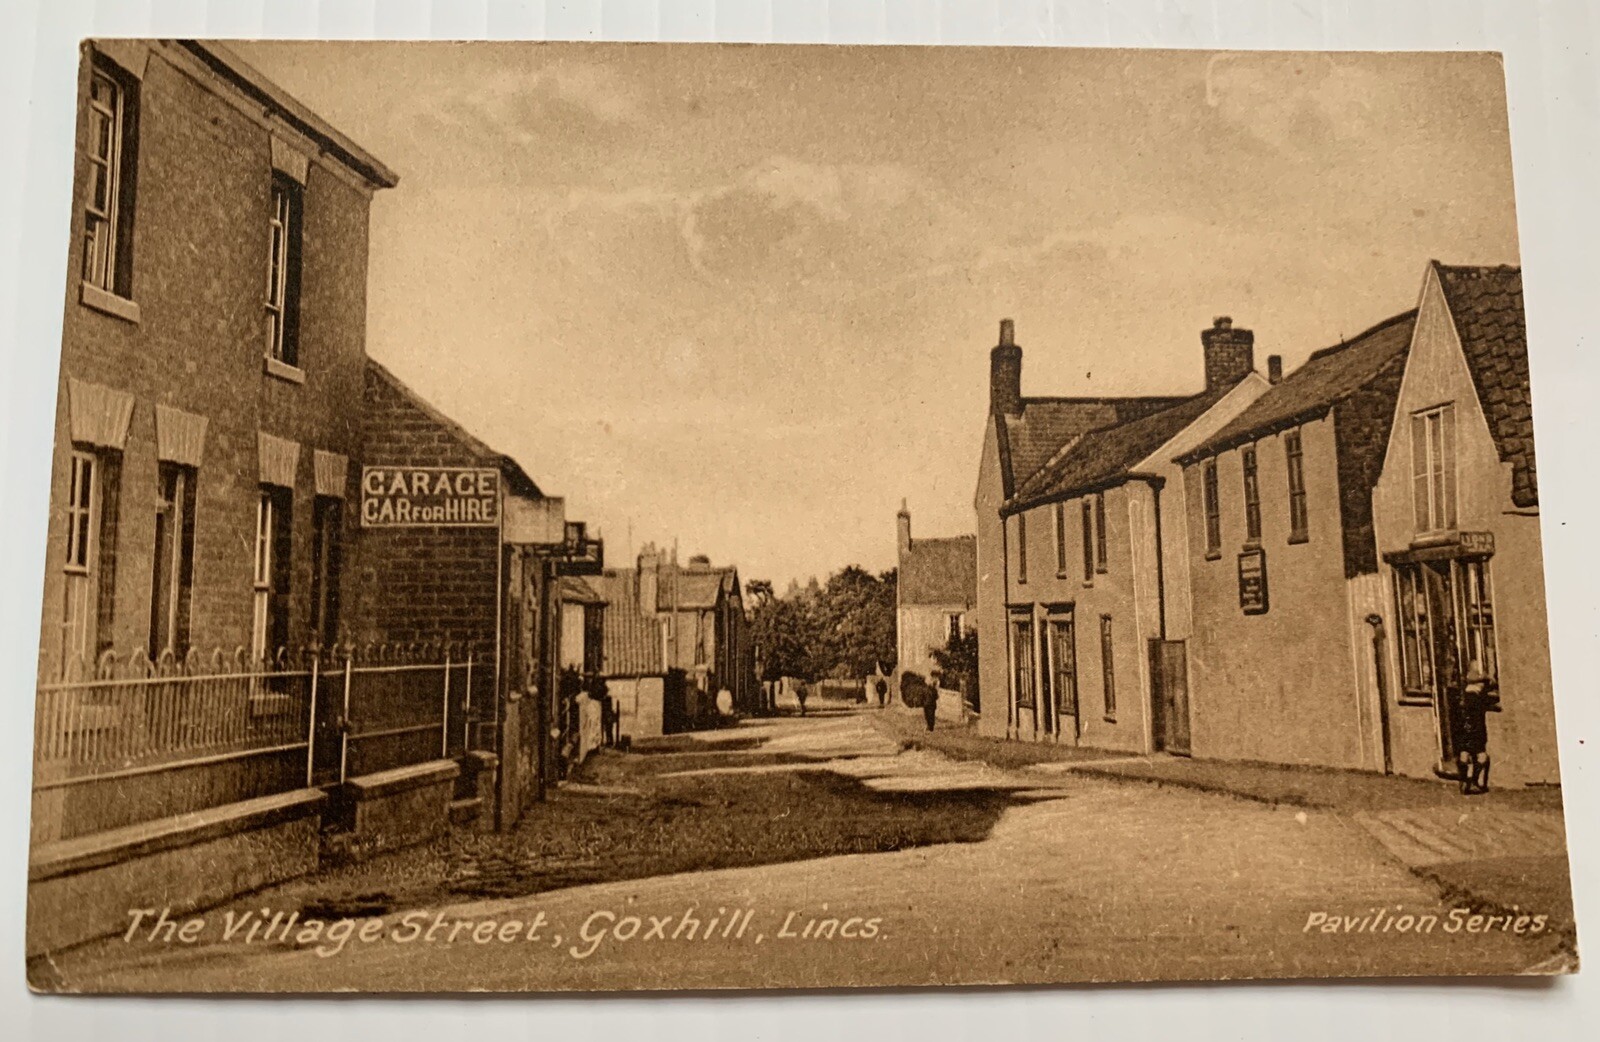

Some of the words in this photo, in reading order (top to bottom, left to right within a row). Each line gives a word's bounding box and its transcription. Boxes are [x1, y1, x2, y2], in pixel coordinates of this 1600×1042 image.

[364, 470, 496, 496] GARAGE
[363, 497, 411, 521] CAR
[445, 497, 494, 521] HIRE
